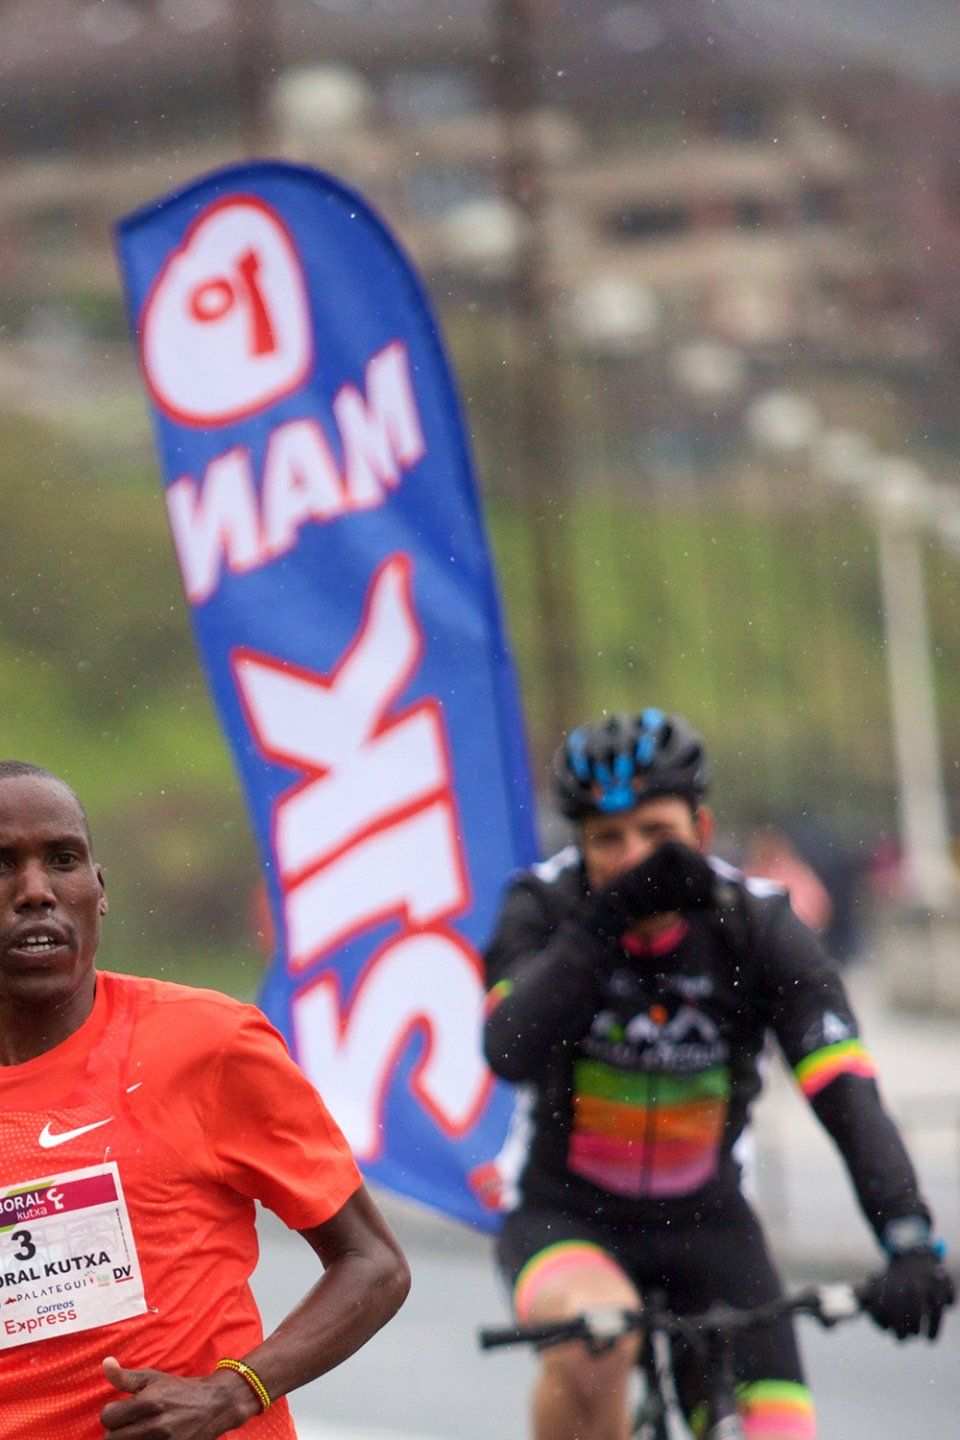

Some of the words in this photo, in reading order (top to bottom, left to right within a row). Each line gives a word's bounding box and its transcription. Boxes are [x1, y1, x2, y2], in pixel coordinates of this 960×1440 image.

[16, 1207, 47, 1221] kutxa
[11, 1230, 36, 1261] 3
[44, 1251, 111, 1277] KUTXA
[112, 1265, 131, 1280] DV
[36, 1300, 74, 1315] Correos
[4, 1309, 77, 1335] Express
